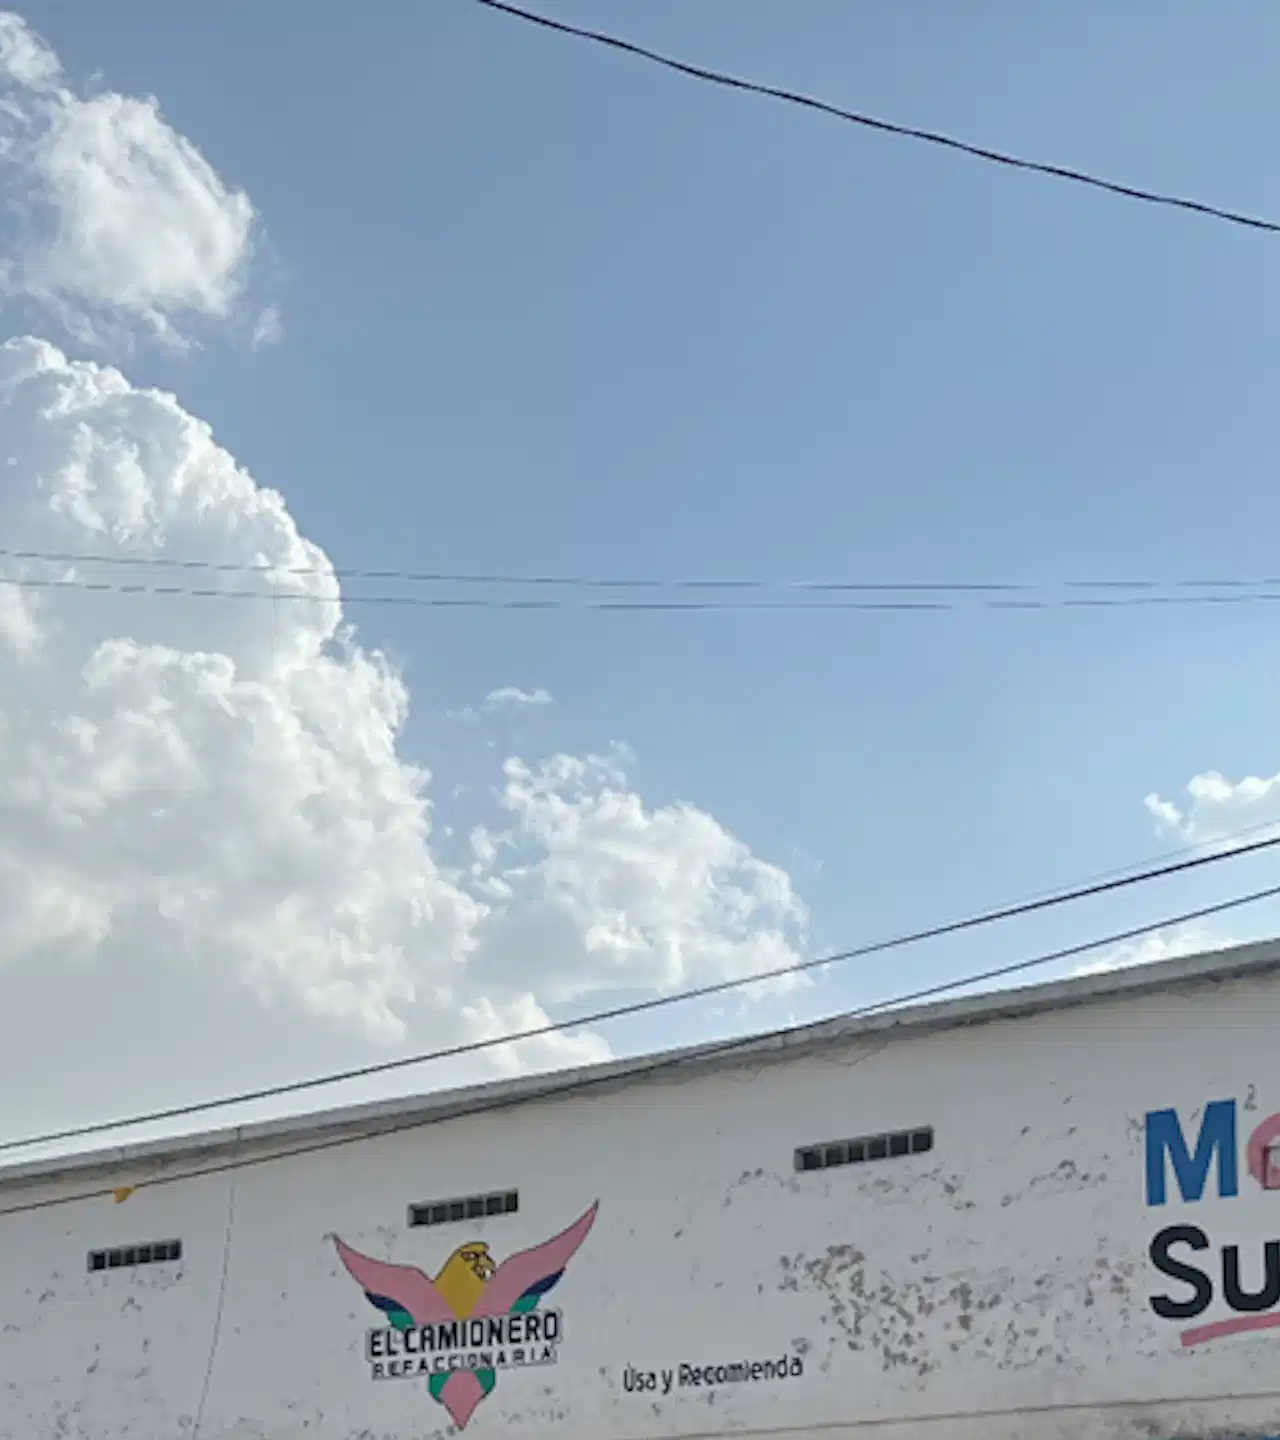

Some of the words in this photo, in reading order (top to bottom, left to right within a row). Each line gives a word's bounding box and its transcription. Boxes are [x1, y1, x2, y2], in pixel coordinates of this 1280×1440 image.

[623, 1365, 656, 1392] Usa
[662, 1369, 673, 1395] y
[678, 1353, 803, 1387] Recomienda
